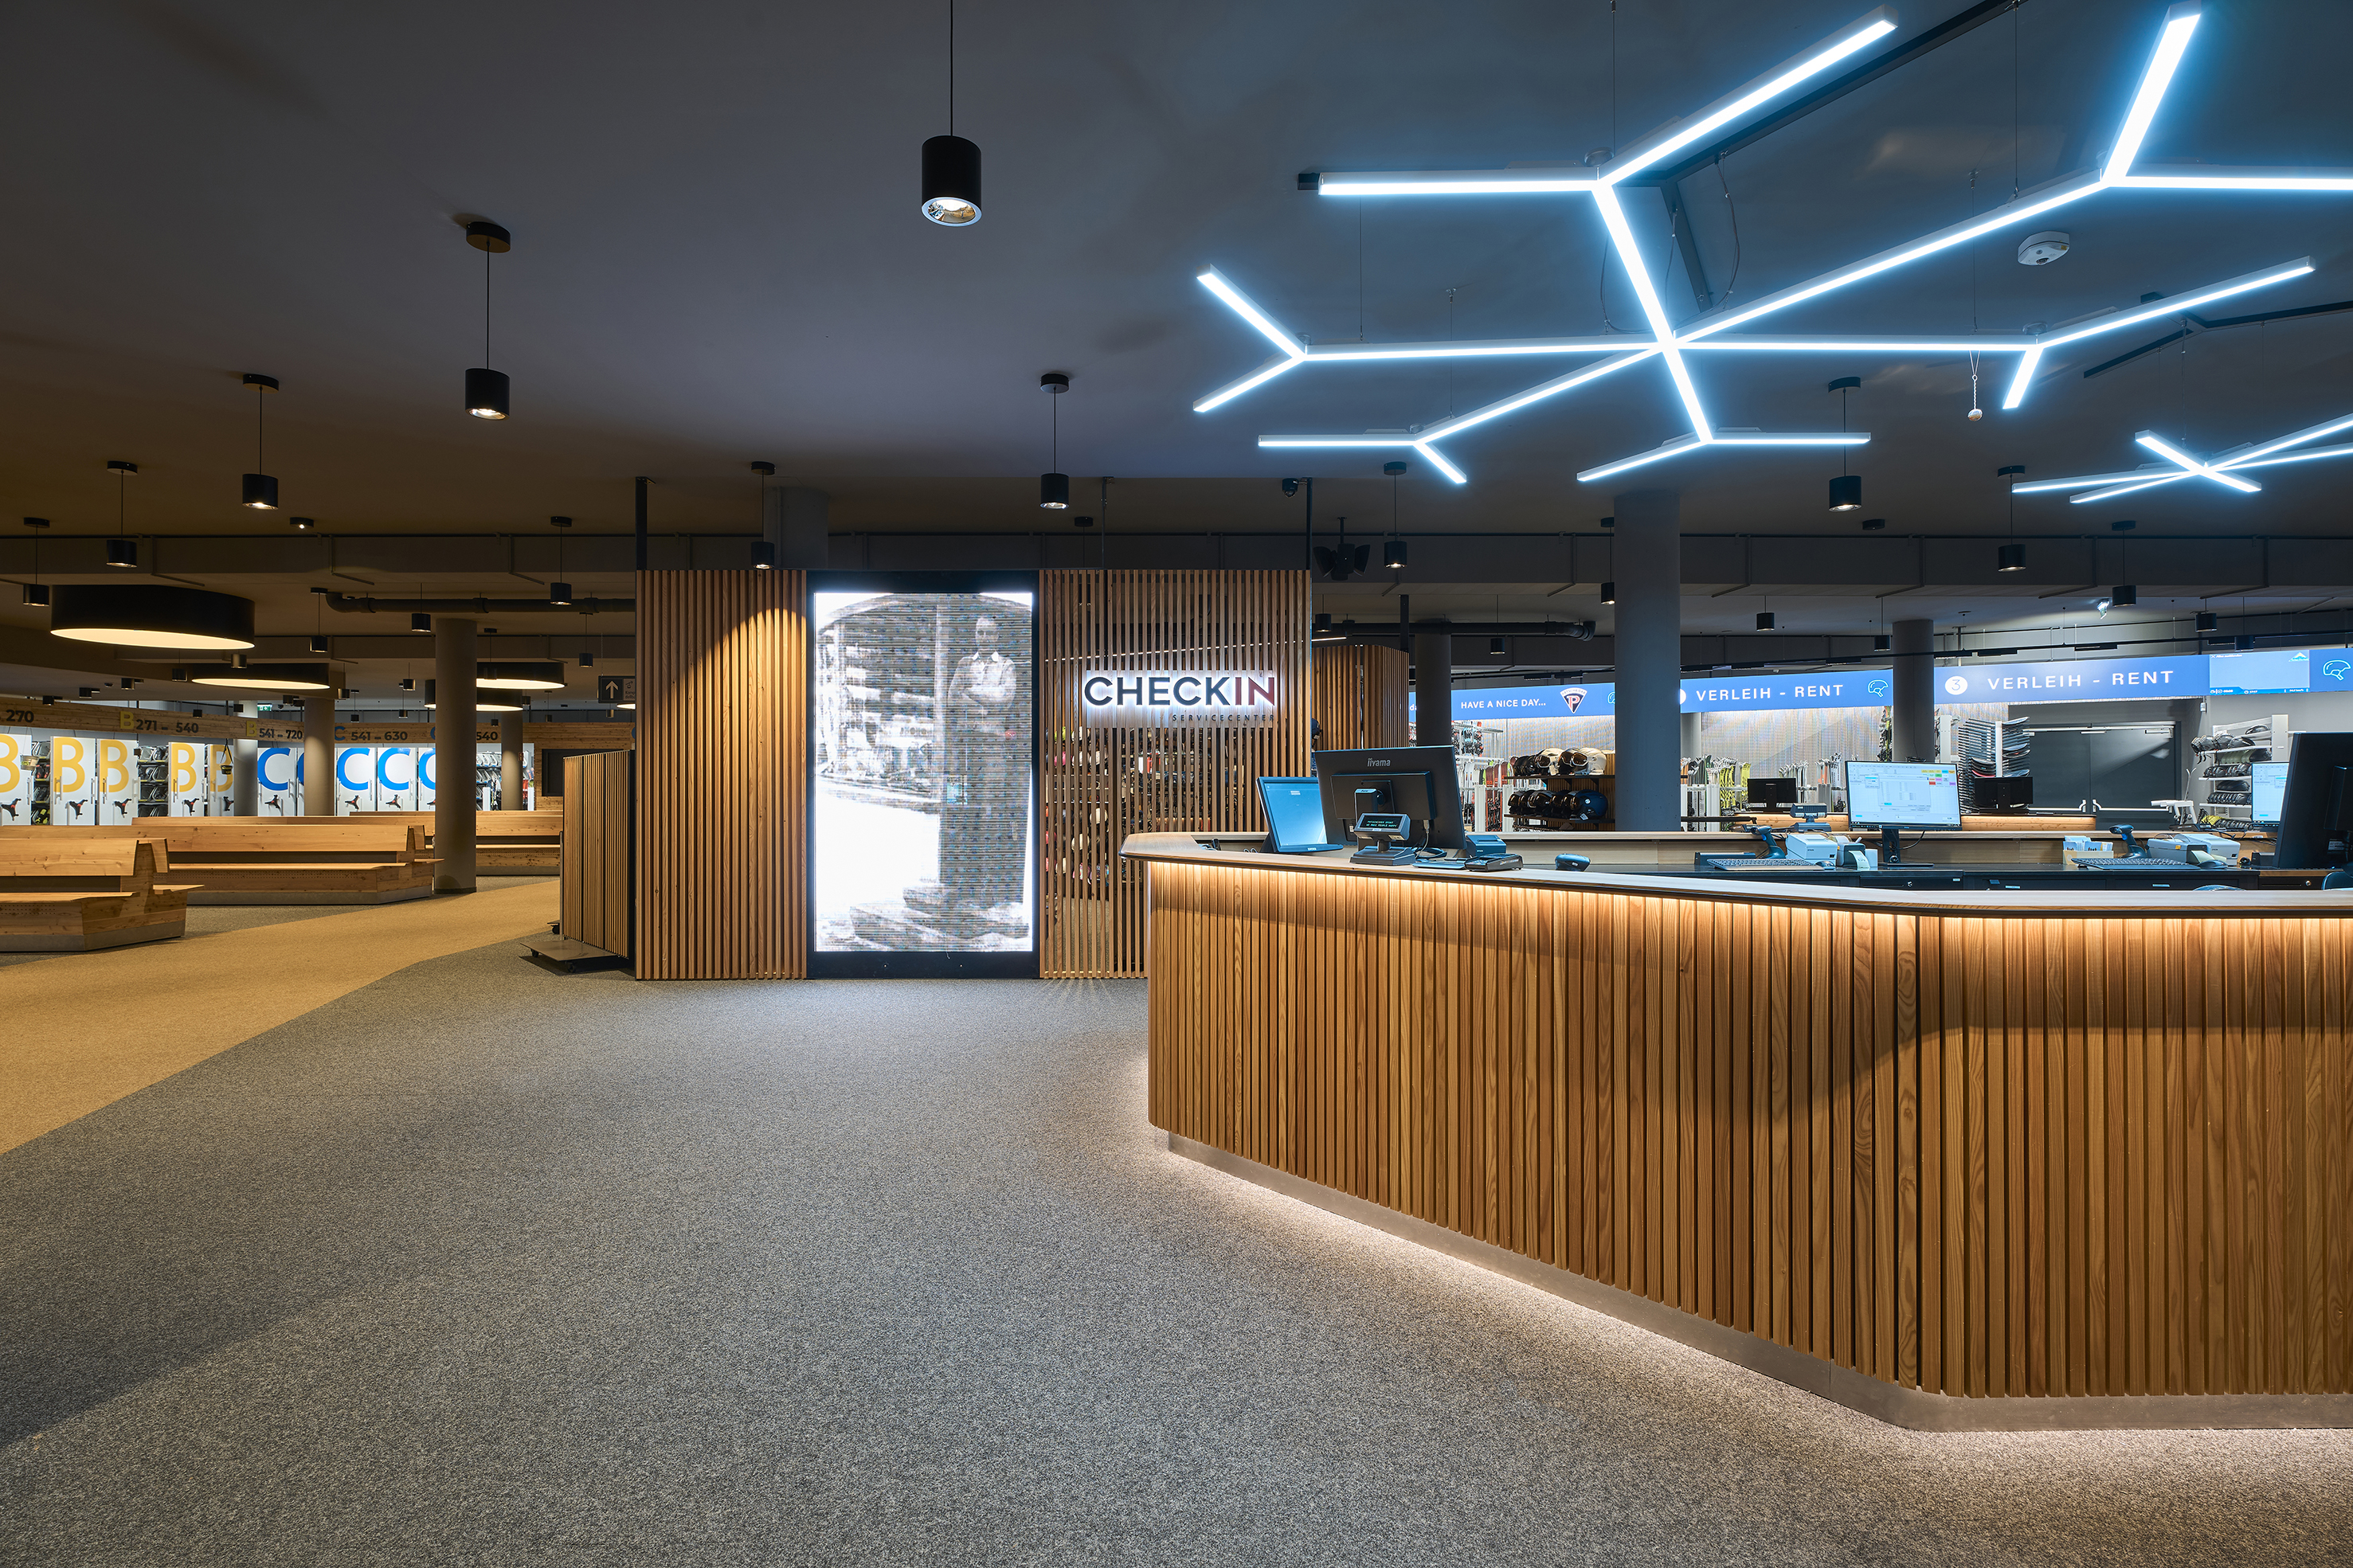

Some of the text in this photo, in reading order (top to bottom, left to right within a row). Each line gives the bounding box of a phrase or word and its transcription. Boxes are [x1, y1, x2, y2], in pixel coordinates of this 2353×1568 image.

[1952, 678, 1961, 691] 3
[1987, 675, 2081, 690] VERLEIH
[2112, 671, 2174, 685] RENT
[1496, 699, 1518, 708] NICE
[1521, 698, 1546, 707] DAY...
[1696, 687, 1771, 702] VERLEIH
[1795, 684, 1843, 698] RENT
[6, 709, 34, 723] 270
[119, 711, 134, 729] B
[136, 719, 157, 732] 271
[175, 722, 199, 733] 540
[245, 721, 257, 737] B
[259, 727, 275, 739] 541
[285, 729, 303, 740] 720
[335, 725, 346, 741] C
[350, 731, 371, 741] 541
[384, 731, 408, 741] 630
[476, 731, 499, 741] 540
[53, 737, 85, 793] B
[100, 739, 130, 793] B
[170, 742, 197, 792] B
[209, 745, 233, 792] B
[257, 747, 291, 791] C
[337, 747, 370, 791] C
[378, 747, 412, 791] C
[1367, 757, 1391, 767] iiyama
